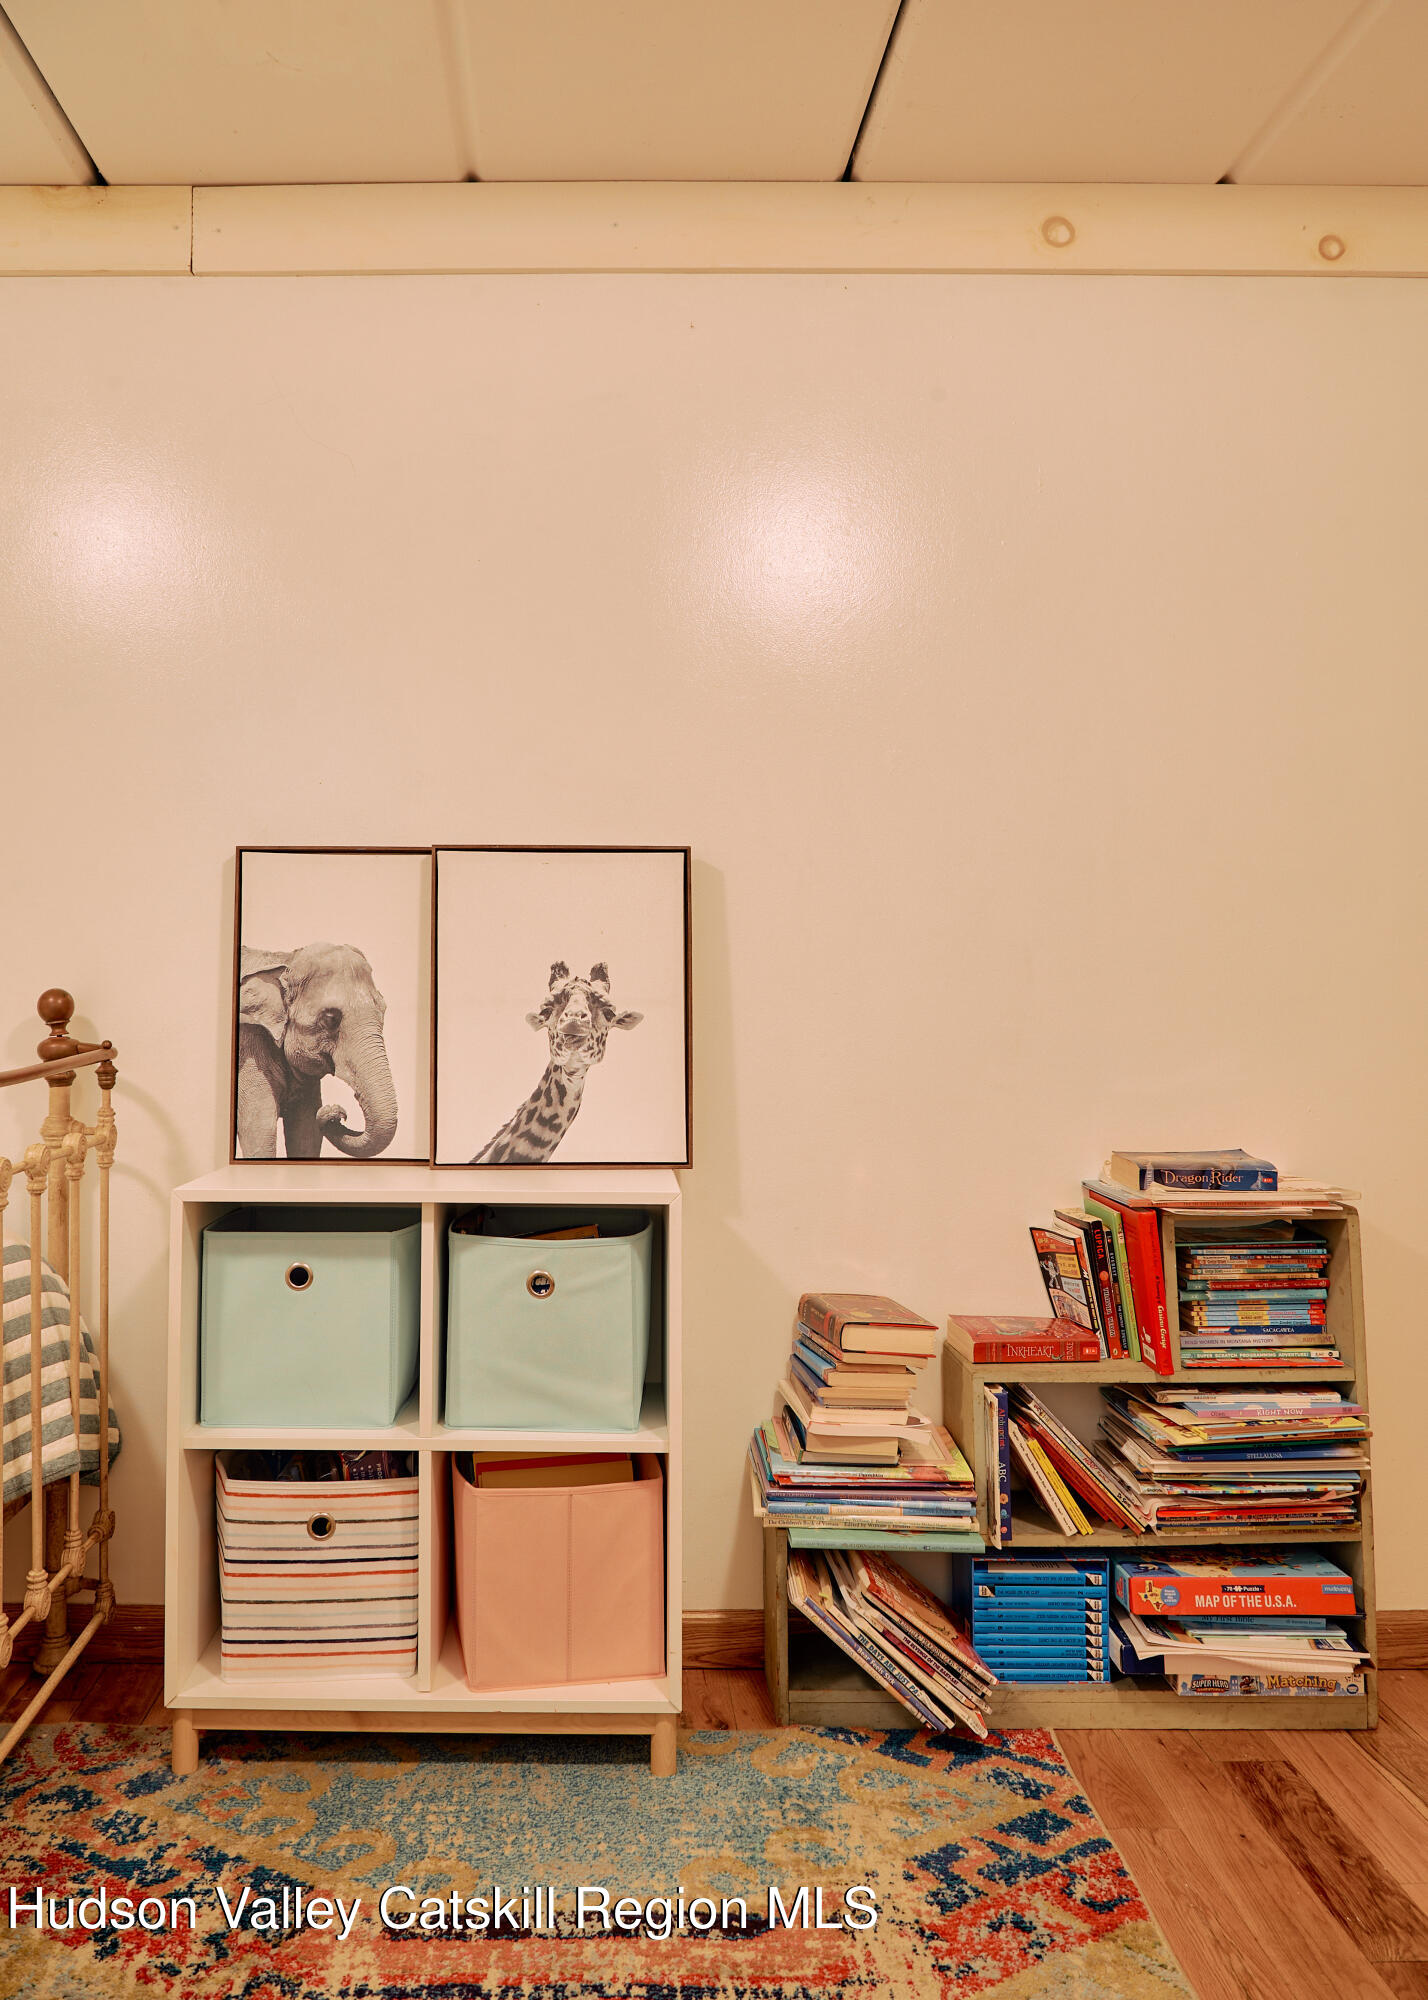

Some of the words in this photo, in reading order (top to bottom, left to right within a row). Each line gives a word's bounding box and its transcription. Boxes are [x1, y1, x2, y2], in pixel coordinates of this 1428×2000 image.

[1164, 1170, 1208, 1184] Dragon
[1211, 1170, 1244, 1184] Rider
[1093, 1229, 1104, 1259] LUPICA
[1158, 1325, 1167, 1349] George
[1007, 1344, 1054, 1358] INKHEART
[1256, 1408, 1282, 1416] RIGHT
[1195, 1595, 1220, 1608] MAP
[1222, 1595, 1239, 1608] OF
[1241, 1595, 1262, 1607] THE
[1264, 1595, 1297, 1608] U.S.A.
[909, 1642, 928, 1660] REVENGE
[856, 1633, 870, 1646] THE
[867, 1644, 885, 1661] DAYS
[882, 1659, 896, 1673] ARE
[894, 1670, 910, 1685] JUST
[882, 1671, 896, 1685] Sick
[1191, 1680, 1211, 1688] SUPER
[1212, 1679, 1229, 1688] HERO
[1266, 1675, 1337, 1692] Matching
